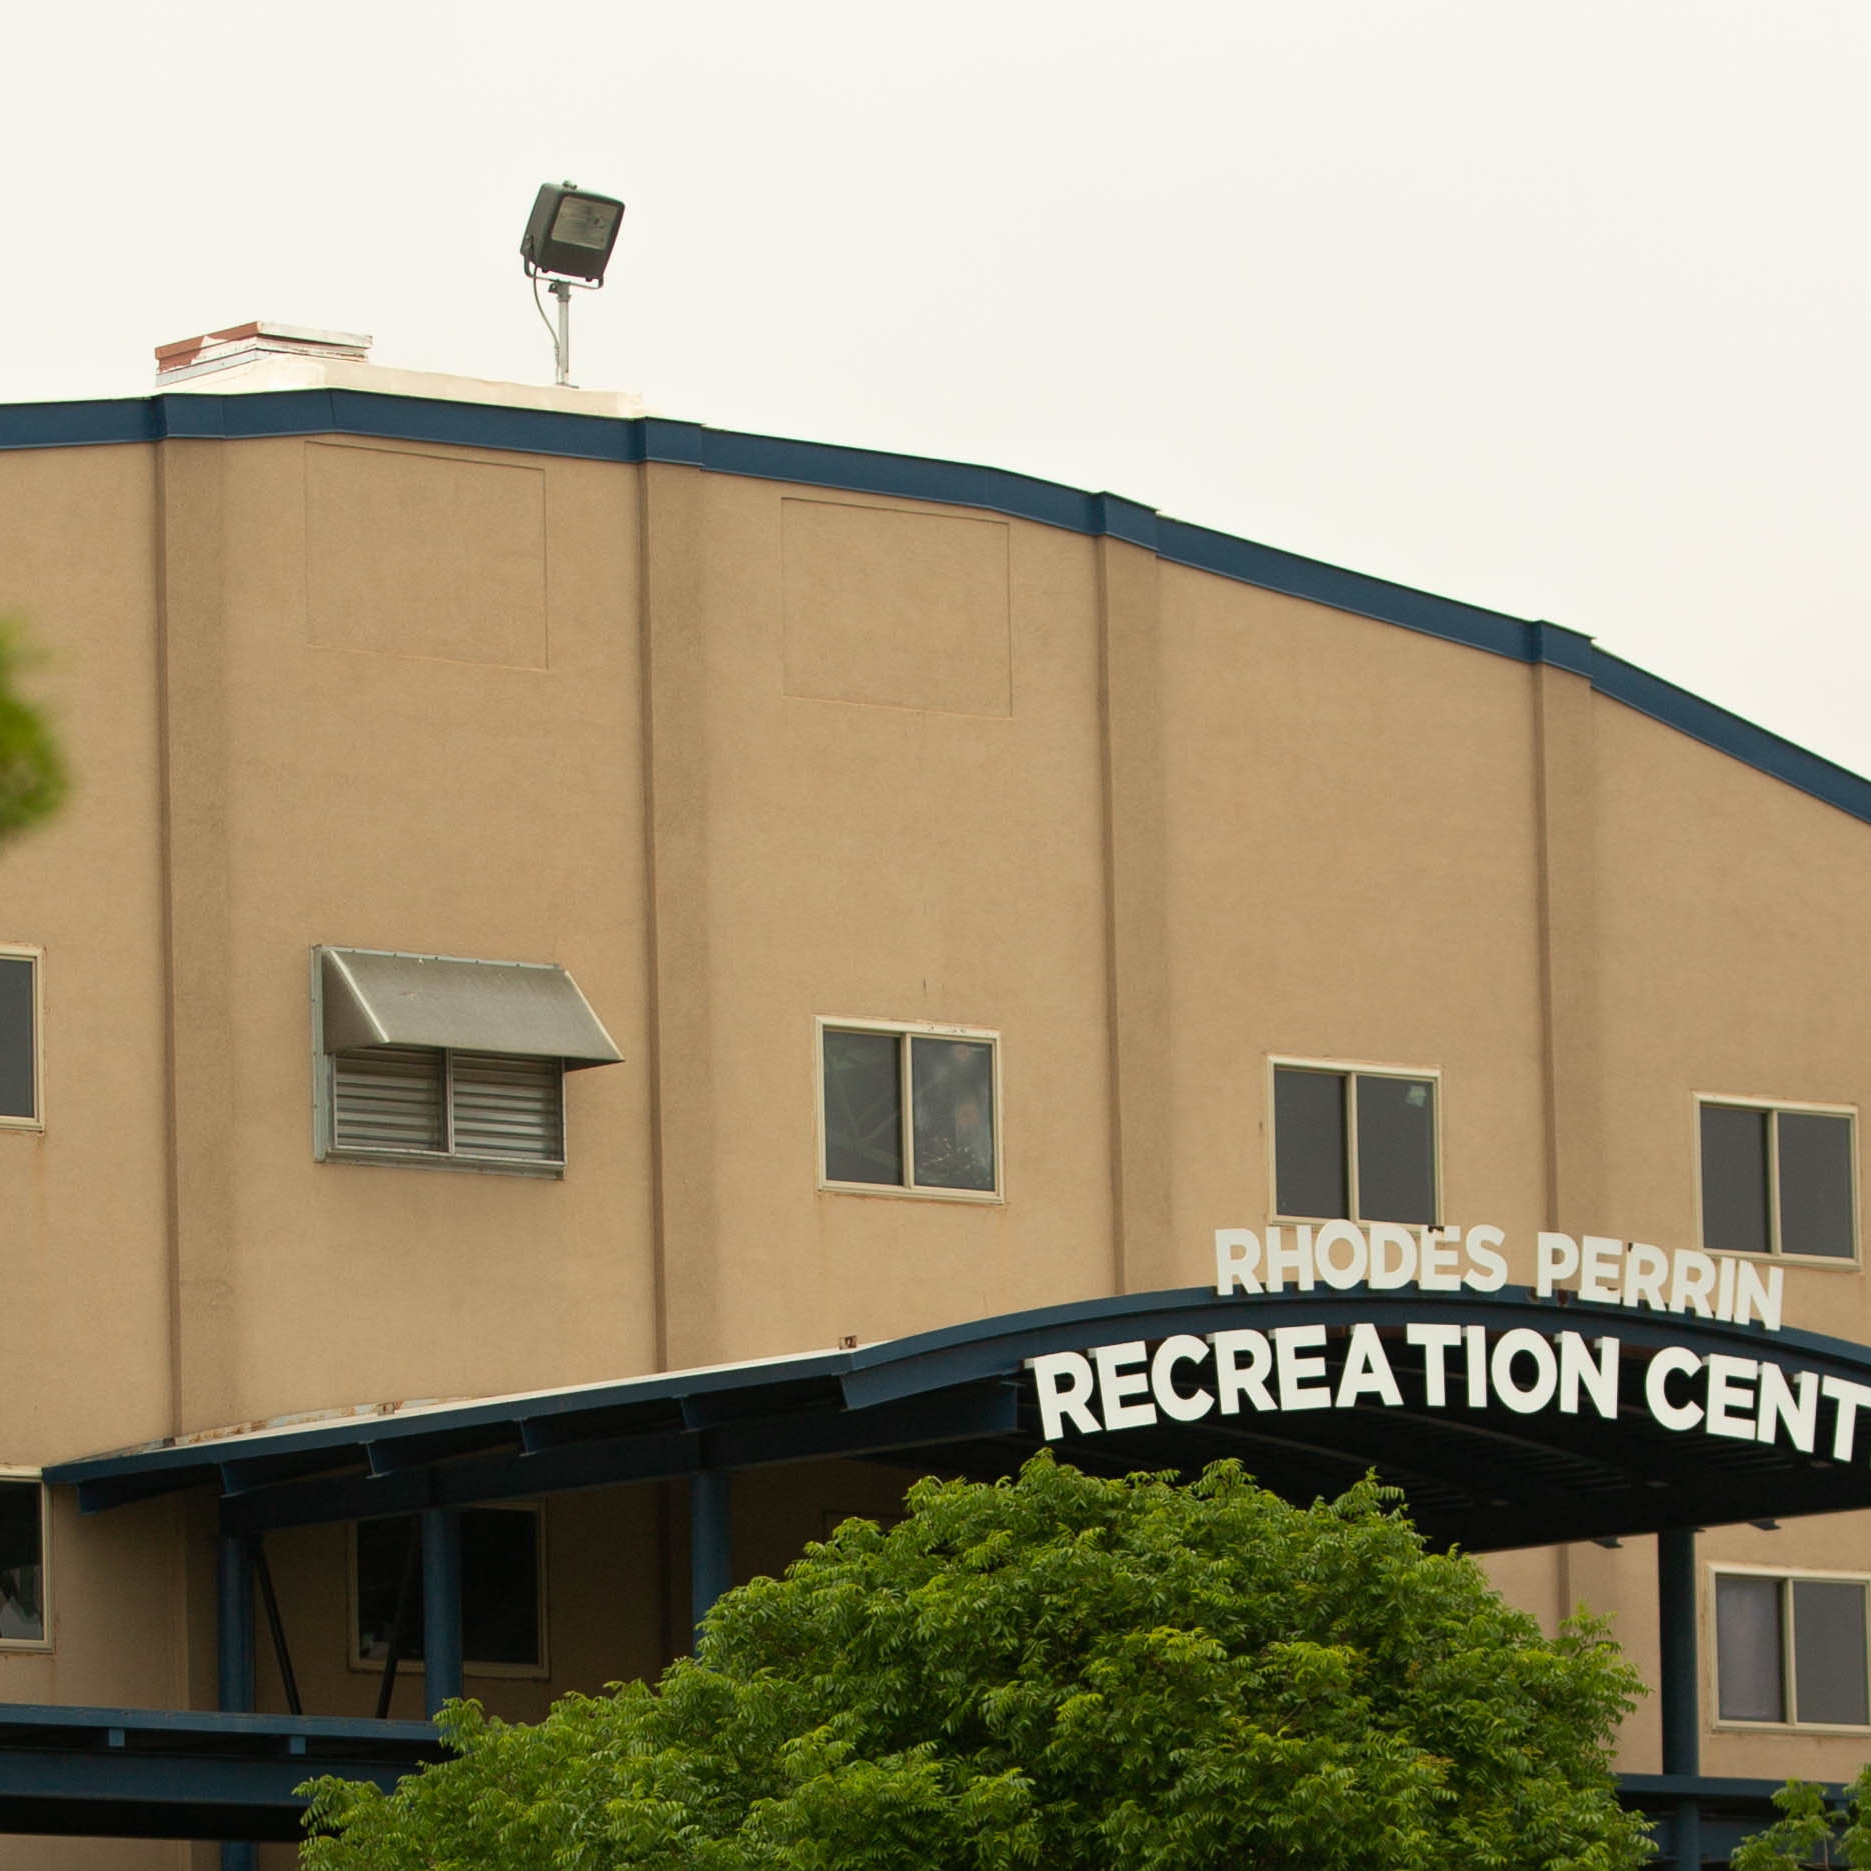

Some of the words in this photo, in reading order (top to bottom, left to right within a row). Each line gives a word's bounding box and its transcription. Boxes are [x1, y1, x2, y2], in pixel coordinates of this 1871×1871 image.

[1214, 1219, 1508, 1296] RHODES
[1537, 1232, 1785, 1332] PERRIN
[1027, 1323, 1620, 1441] RECREATION
